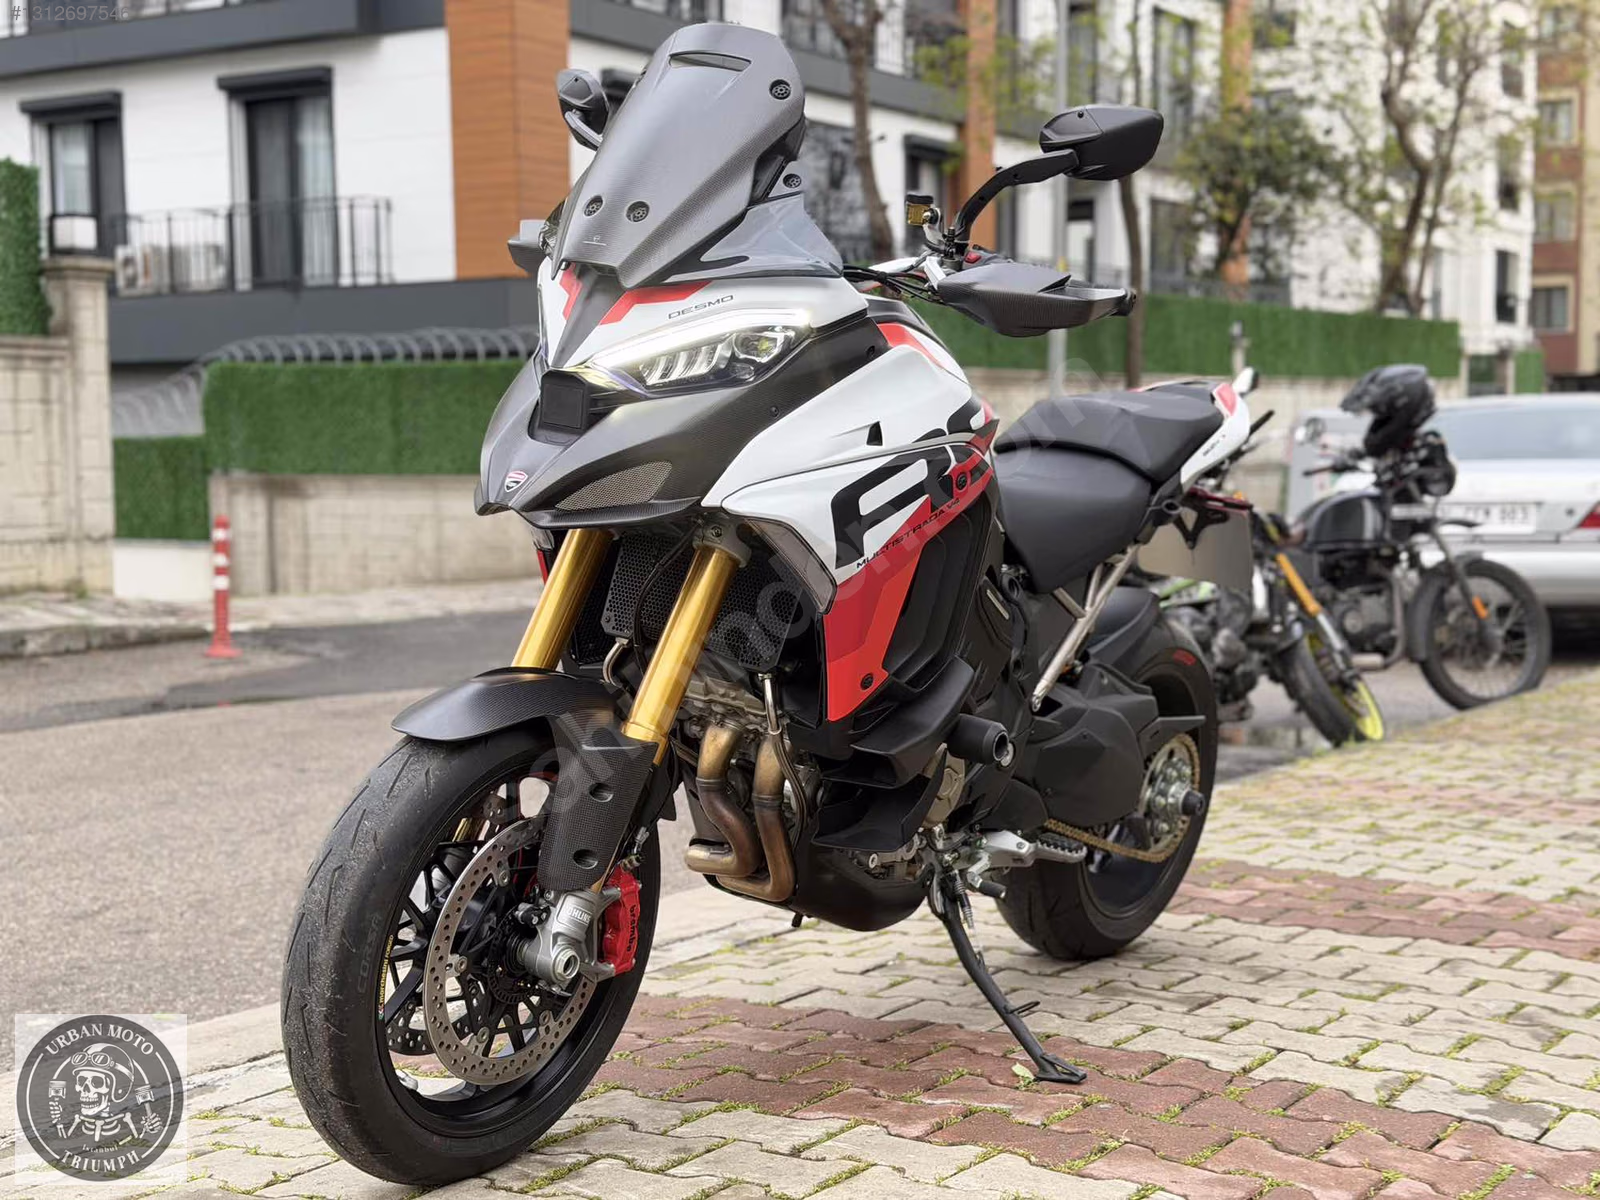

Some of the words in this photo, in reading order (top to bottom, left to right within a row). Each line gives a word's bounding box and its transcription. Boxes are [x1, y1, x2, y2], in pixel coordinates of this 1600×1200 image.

[668, 294, 734, 319] DESMO
[856, 508, 946, 569] MULTISTRADA
[626, 904, 637, 952] brembo
